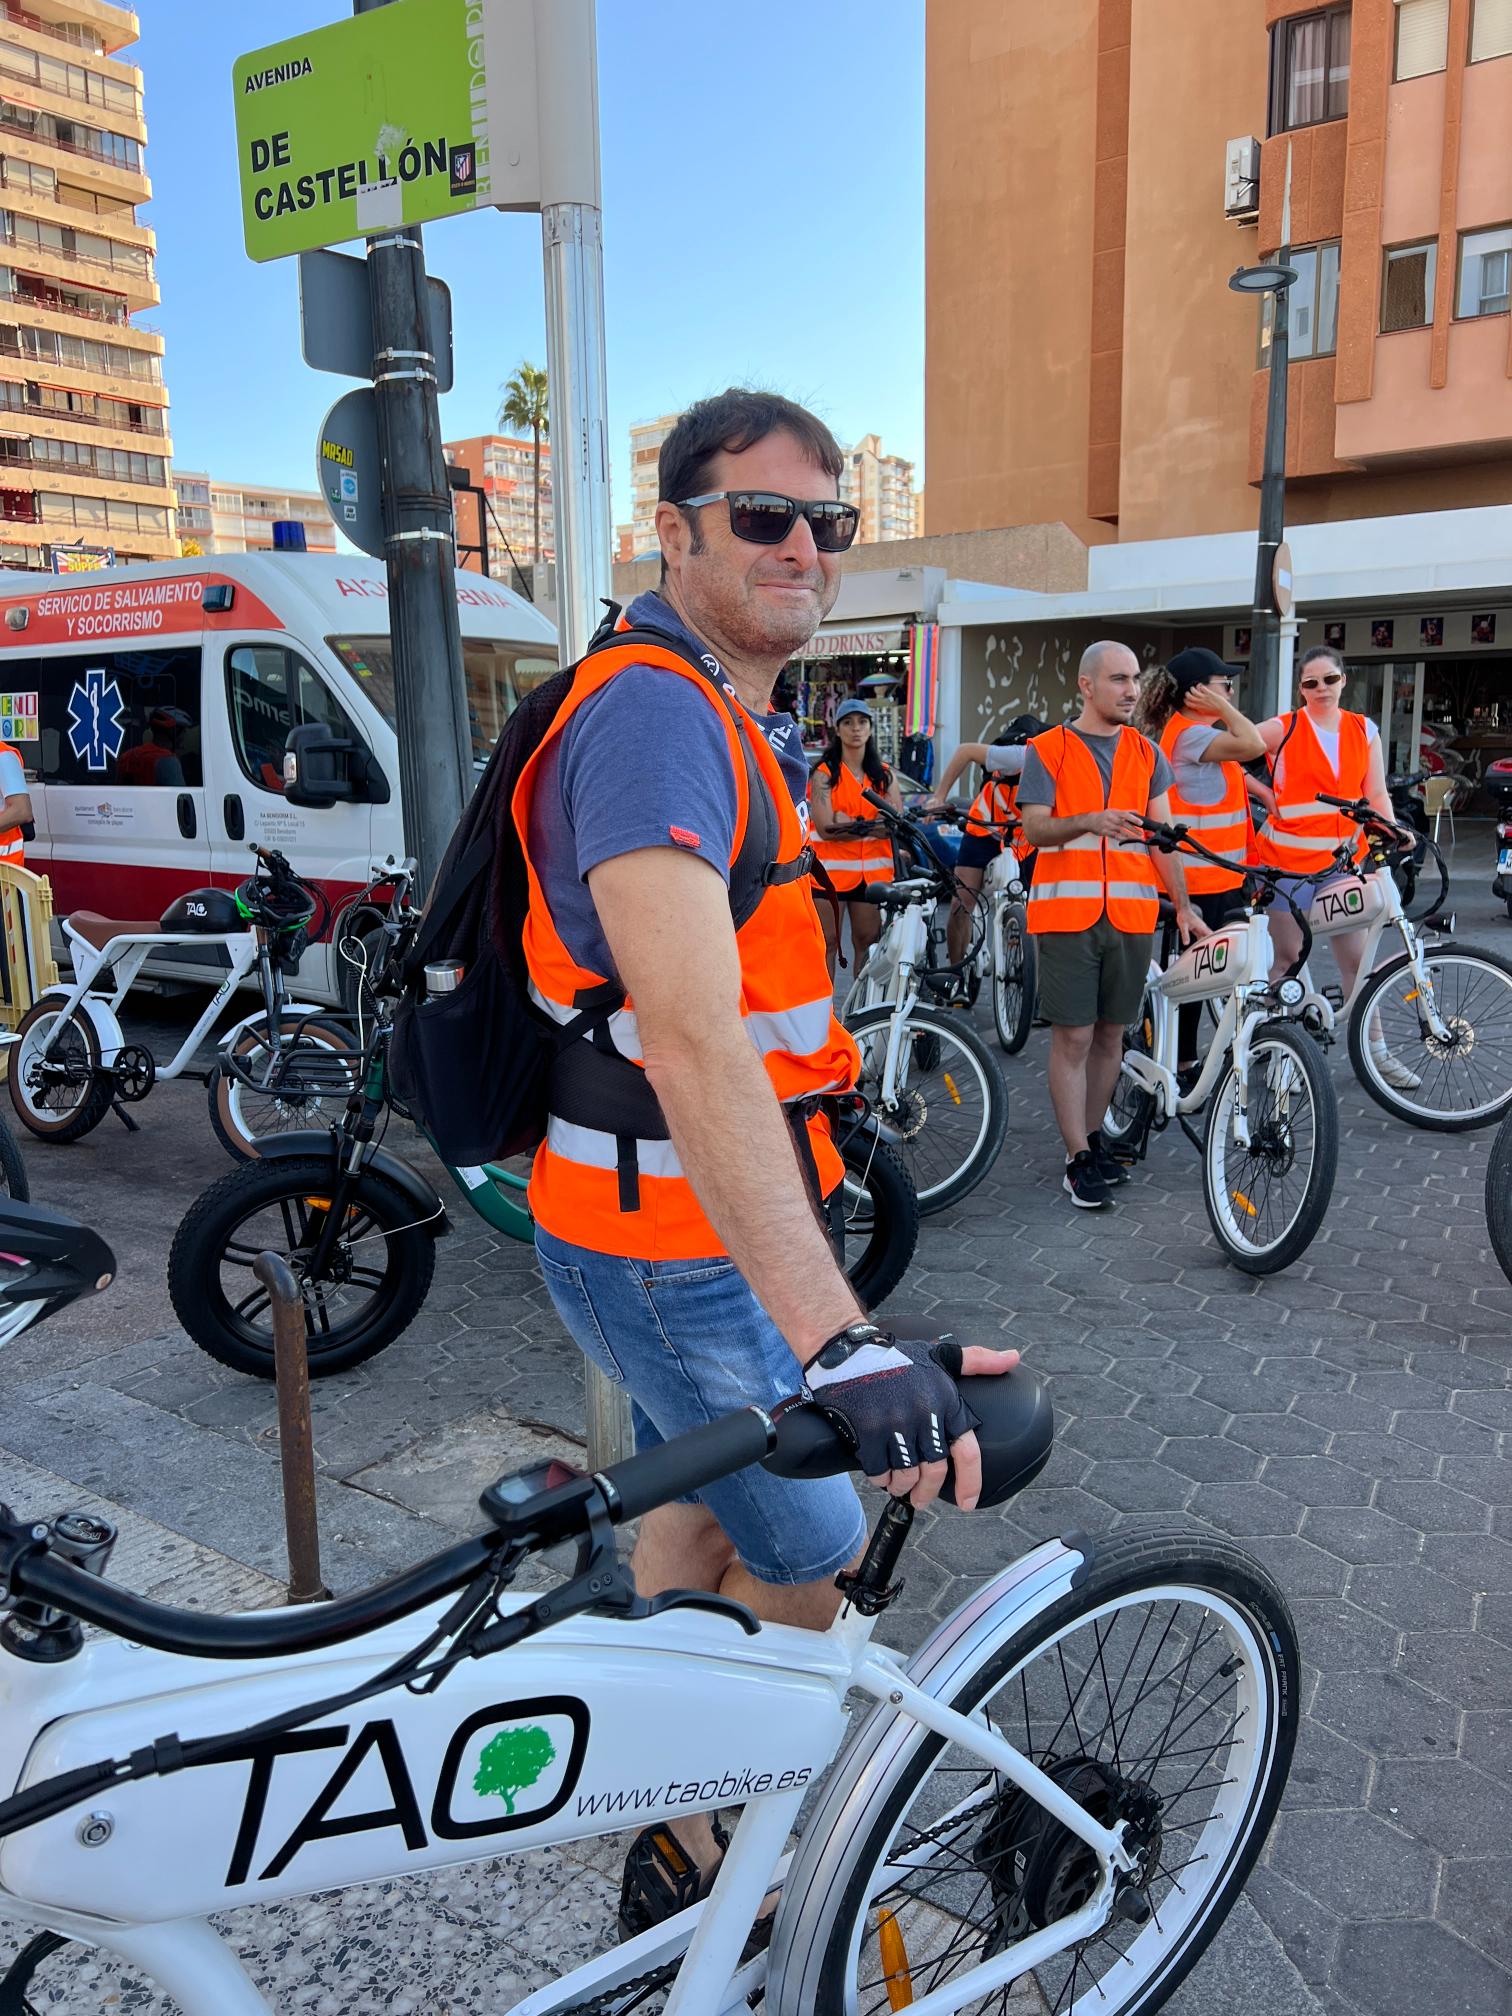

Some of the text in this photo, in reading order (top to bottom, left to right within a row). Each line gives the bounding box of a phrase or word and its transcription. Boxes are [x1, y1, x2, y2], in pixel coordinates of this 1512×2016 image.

[244, 56, 313, 94] AVENIDA
[250, 131, 291, 173] DE
[254, 137, 448, 221] CASTELLÓN
[37, 580, 203, 617] SERVICIO DE SALVAMENTO
[66, 609, 163, 636] Y SOCORRISMO
[828, 631, 885, 653] DRINKS
[186, 902, 207, 917] TAO
[1316, 887, 1364, 922] TAO
[1192, 938, 1230, 980] TAO
[184, 1695, 590, 1887] TAO
[576, 1762, 813, 1818] www.taobike.es
